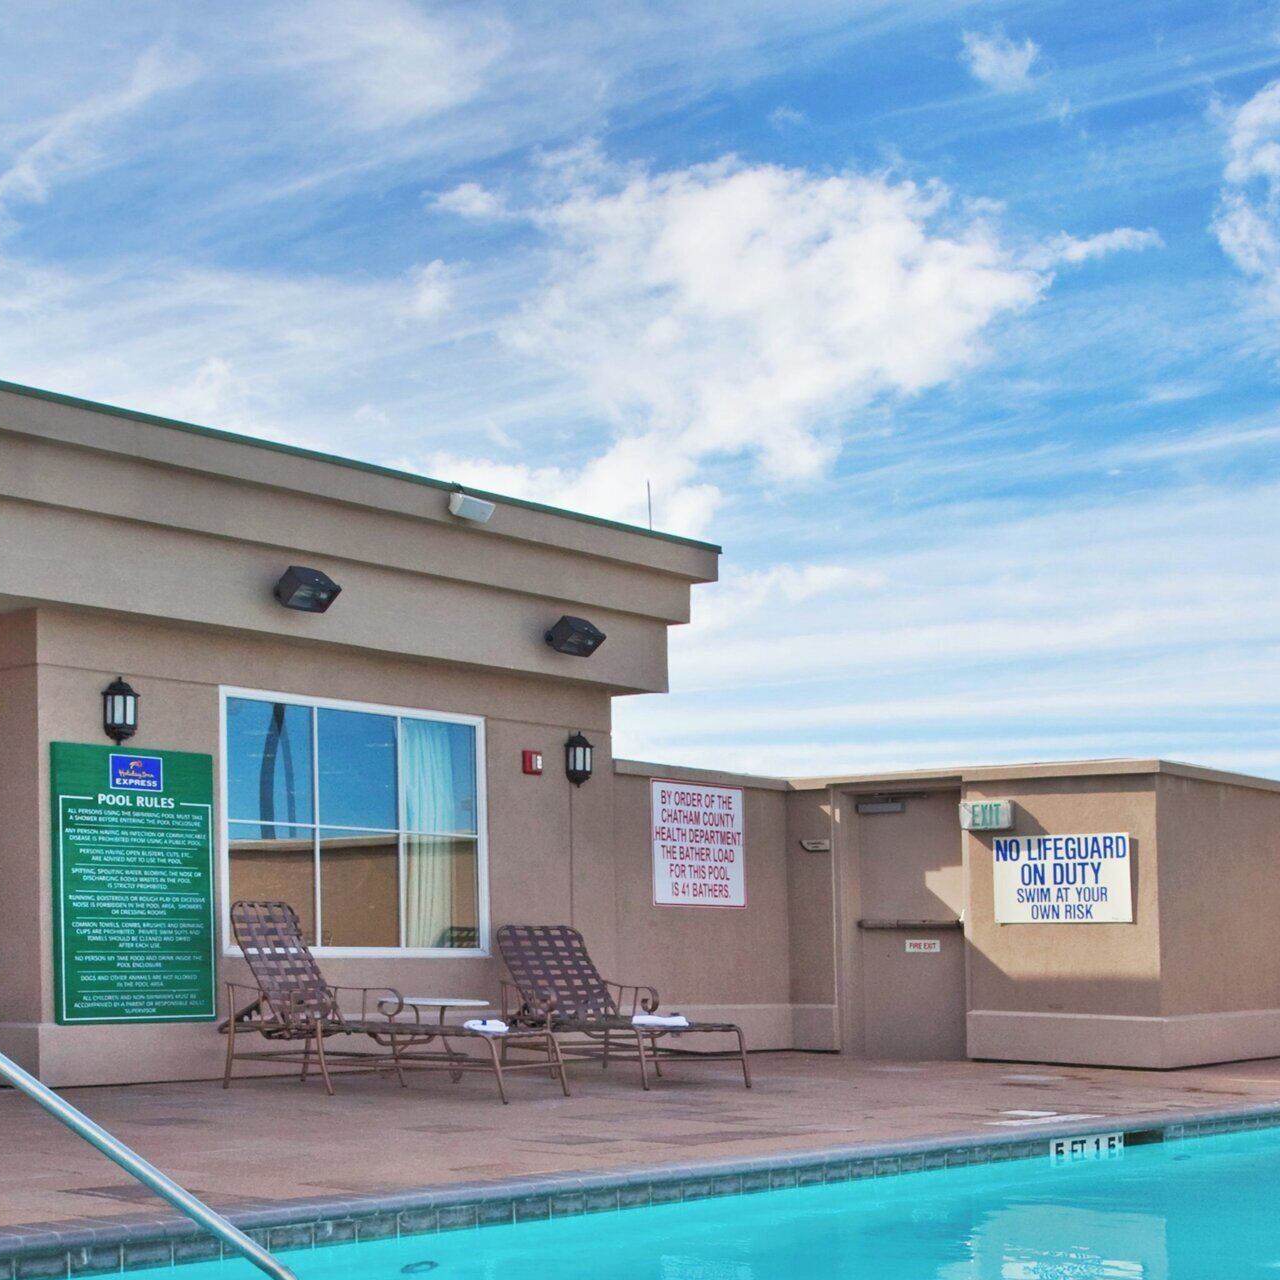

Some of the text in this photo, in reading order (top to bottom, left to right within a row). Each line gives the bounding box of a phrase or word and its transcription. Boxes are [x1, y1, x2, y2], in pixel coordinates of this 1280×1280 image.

[116, 778, 157, 787] EXPRESS
[98, 793, 175, 809] POOL RULES
[661, 790, 732, 809] BY ORDER OF THE
[661, 809, 735, 827] CHATHAM COUNTY
[972, 804, 1001, 827] EXIT
[656, 827, 741, 846] HEALTH DEPARTMENT
[661, 845, 734, 862] THE BATHER LOAD
[996, 836, 1126, 861] NO LIFEGUARD
[670, 864, 730, 881] FOR THIS POOL
[1021, 862, 1102, 886] ON DUTY
[672, 882, 731, 898] IS 41 BATHERS.
[1017, 887, 1108, 902] SWIM AT YOUR
[1031, 904, 1094, 920] OWN RISK
